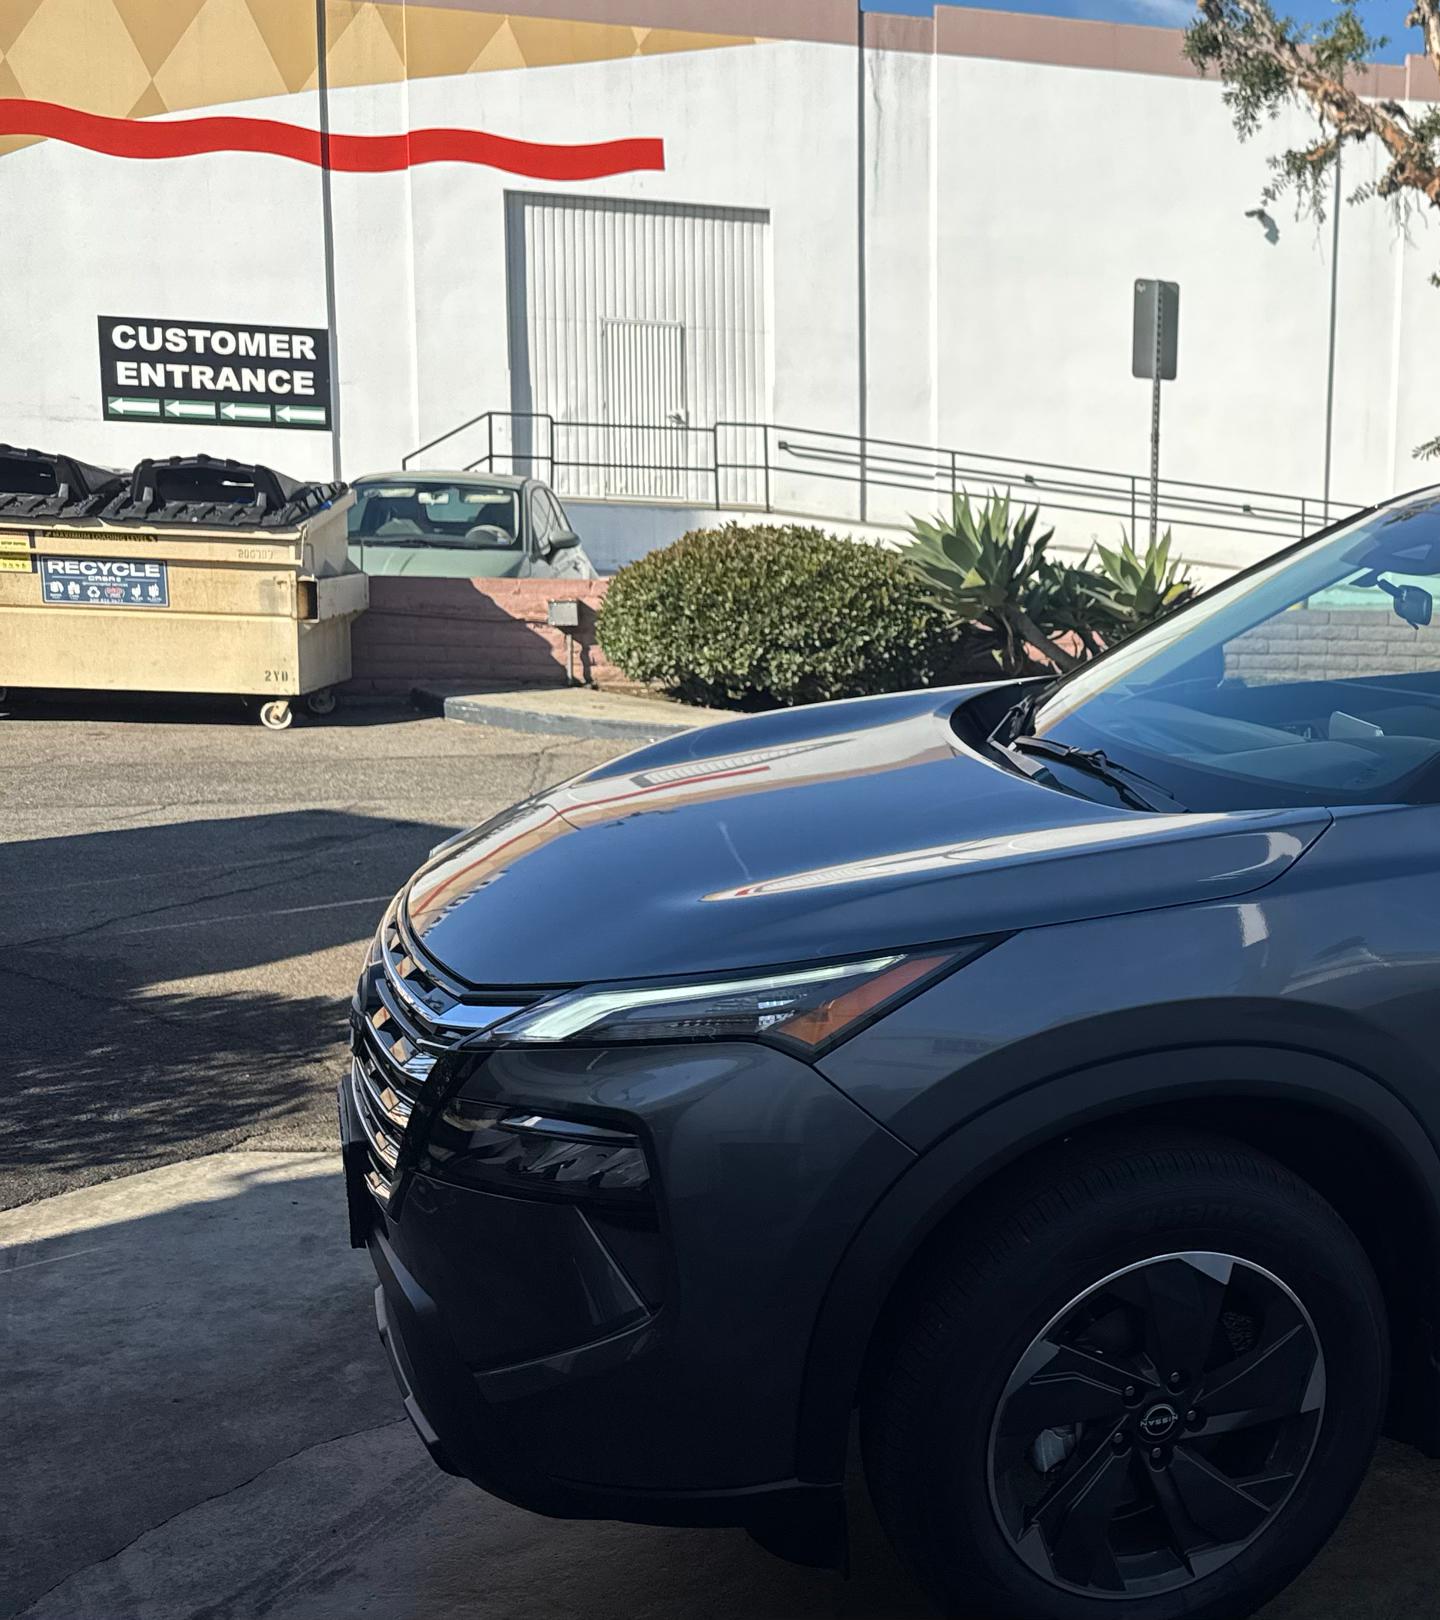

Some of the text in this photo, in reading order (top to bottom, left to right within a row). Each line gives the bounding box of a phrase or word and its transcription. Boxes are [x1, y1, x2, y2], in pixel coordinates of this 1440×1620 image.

[111, 324, 317, 360] CUSTOMER
[115, 361, 316, 396] ENTRANCE
[47, 559, 161, 577] RECYCLE
